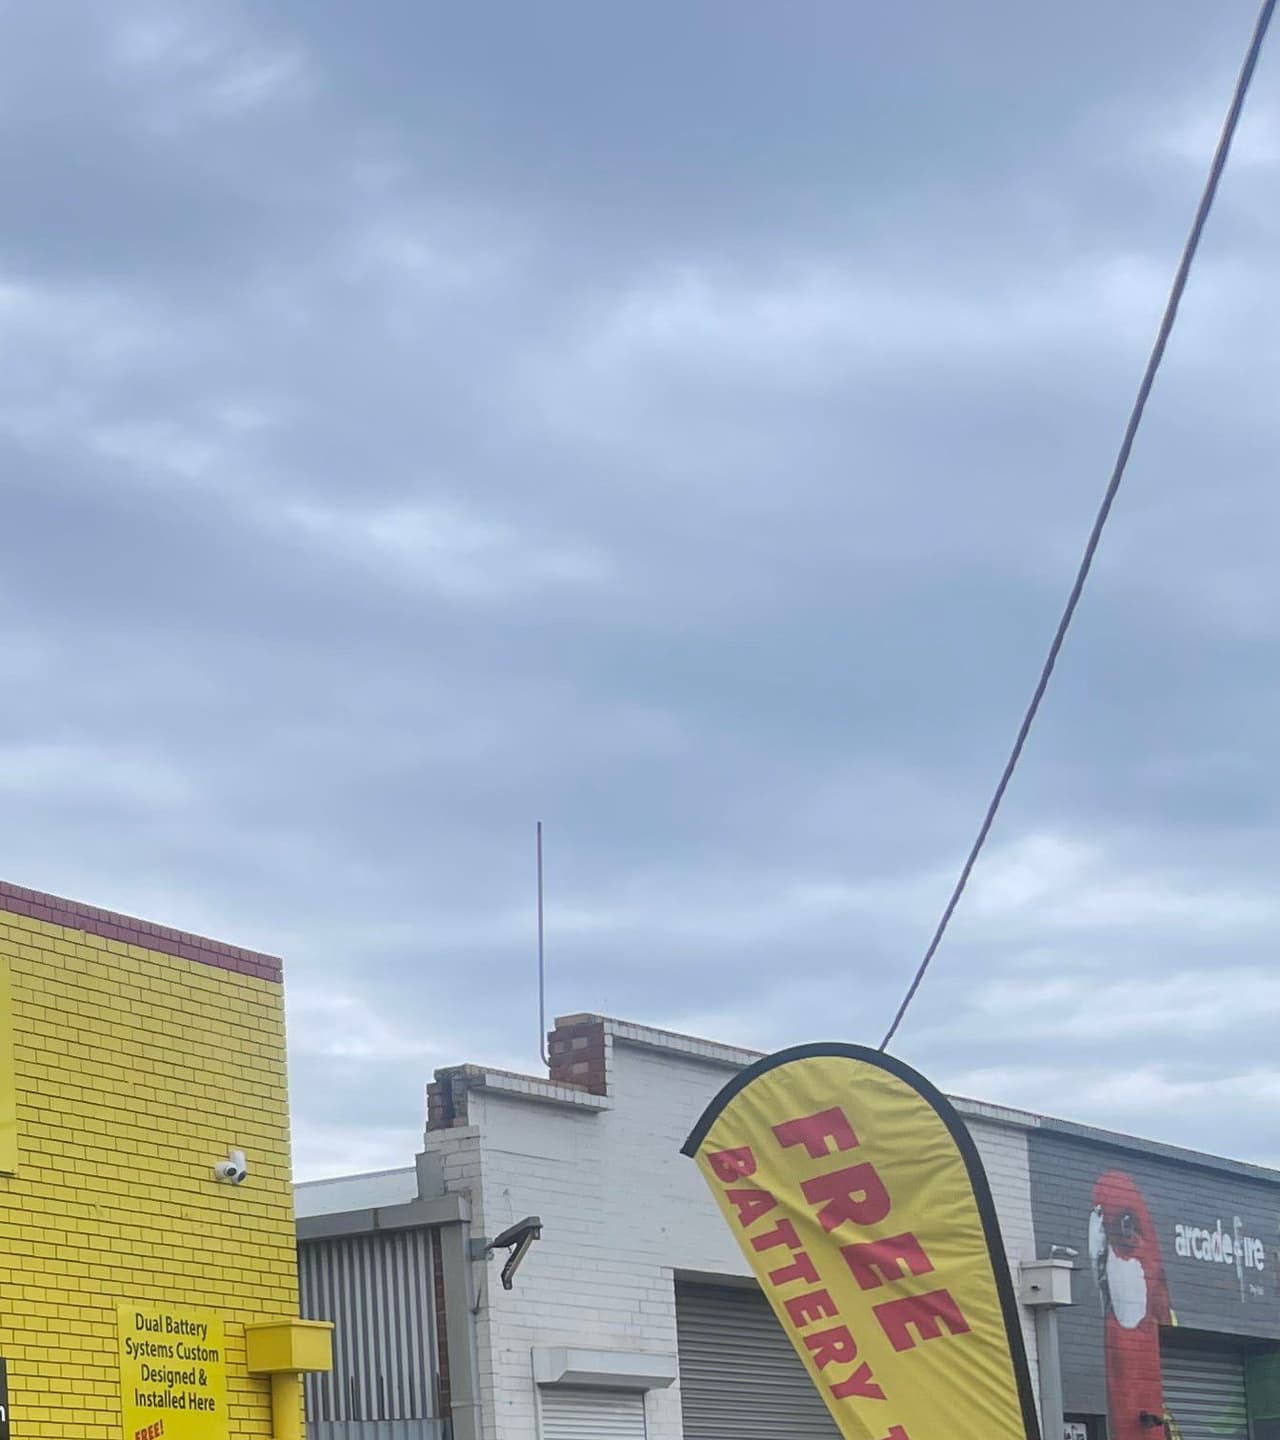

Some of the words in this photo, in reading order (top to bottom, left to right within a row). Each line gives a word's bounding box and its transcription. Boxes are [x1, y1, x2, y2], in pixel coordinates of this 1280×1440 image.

[771, 1106, 971, 1353] FREE
[707, 1145, 888, 1401] BATTERY
[135, 1313, 163, 1332] Dual
[166, 1316, 208, 1341] Battery
[125, 1337, 173, 1360] Systems
[176, 1342, 219, 1362] Custom
[141, 1364, 195, 1388] Designed
[198, 1368, 207, 1386] &
[135, 1389, 185, 1410] Installed
[189, 1393, 215, 1411] Here
